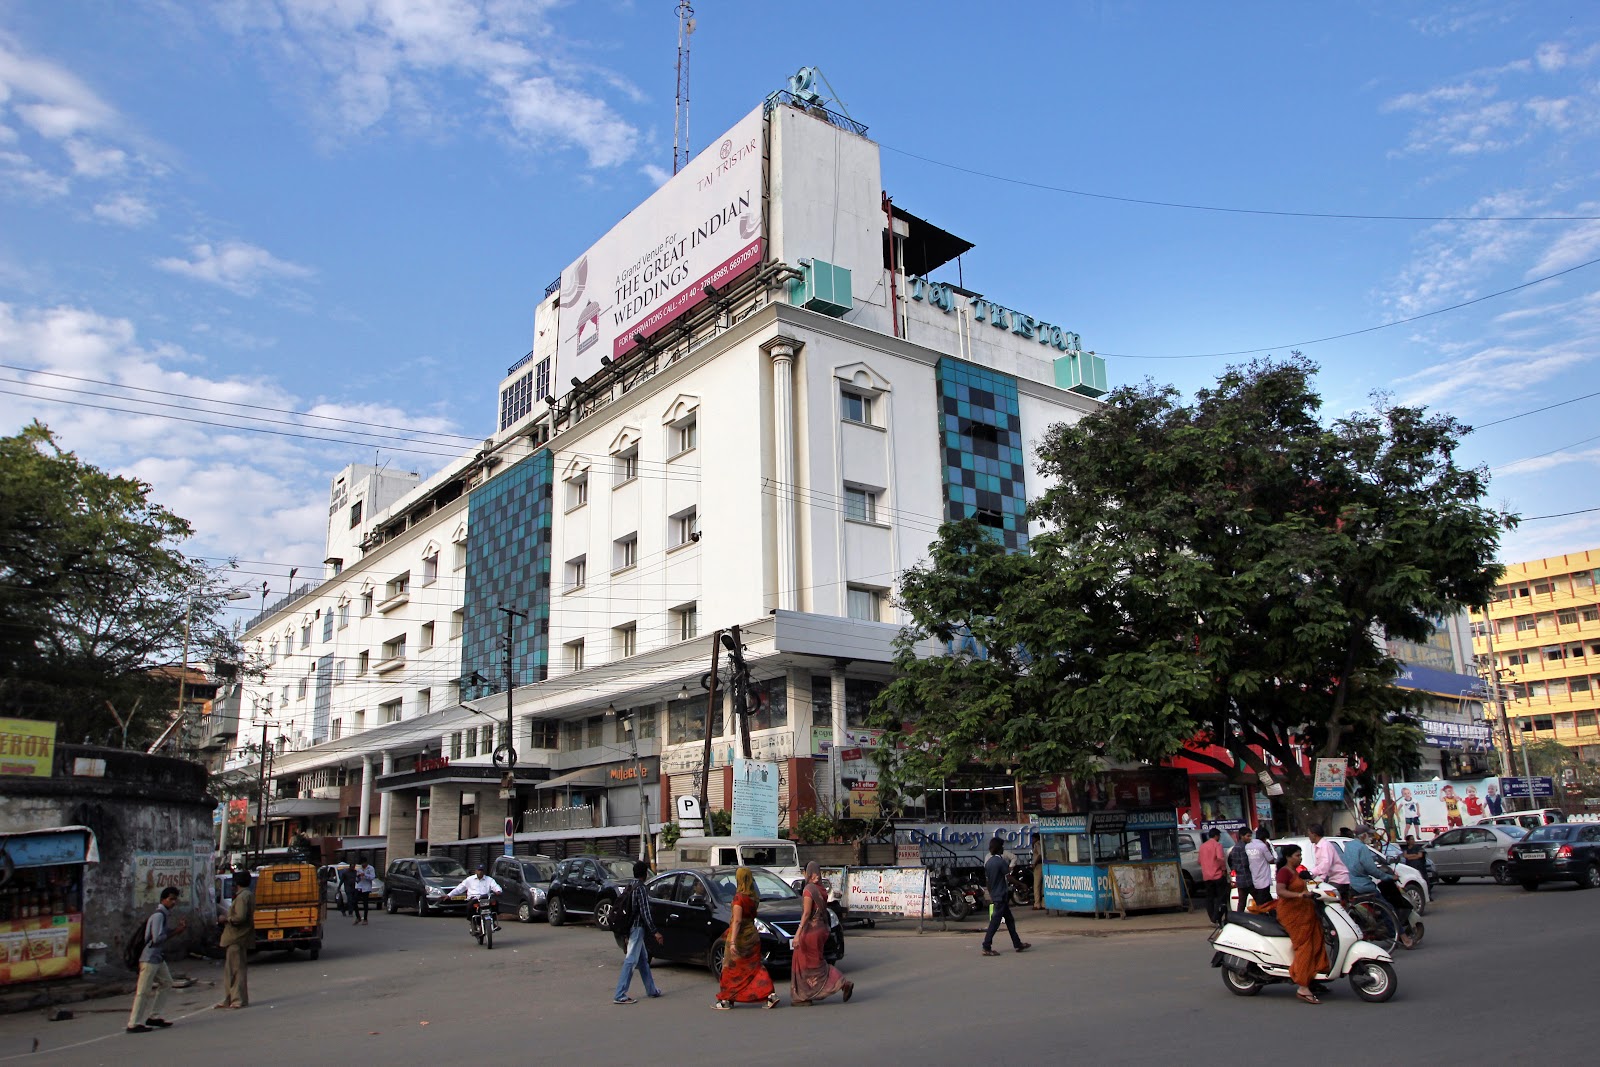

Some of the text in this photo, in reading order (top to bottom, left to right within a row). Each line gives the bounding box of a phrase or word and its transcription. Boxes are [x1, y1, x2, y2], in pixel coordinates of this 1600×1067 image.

[716, 138, 756, 177] TRISTAR
[614, 189, 750, 306] THE GREAT INDIAN
[615, 233, 678, 287] A Grand Venue For
[613, 260, 689, 327] WEDDINGS
[618, 333, 629, 348] FOR
[662, 302, 678, 318] CALL:
[678, 293, 688, 306] +91
[689, 287, 697, 299] 40
[729, 244, 759, 271] 66970970
[684, 799, 694, 811] P
[1138, 811, 1174, 823] CONTROL
[1039, 817, 1056, 826] POLICE
[1056, 816, 1066, 826] SUB
[910, 826, 984, 850] Galaxy
[1044, 875, 1094, 892] POLICE SUB CONTROL
